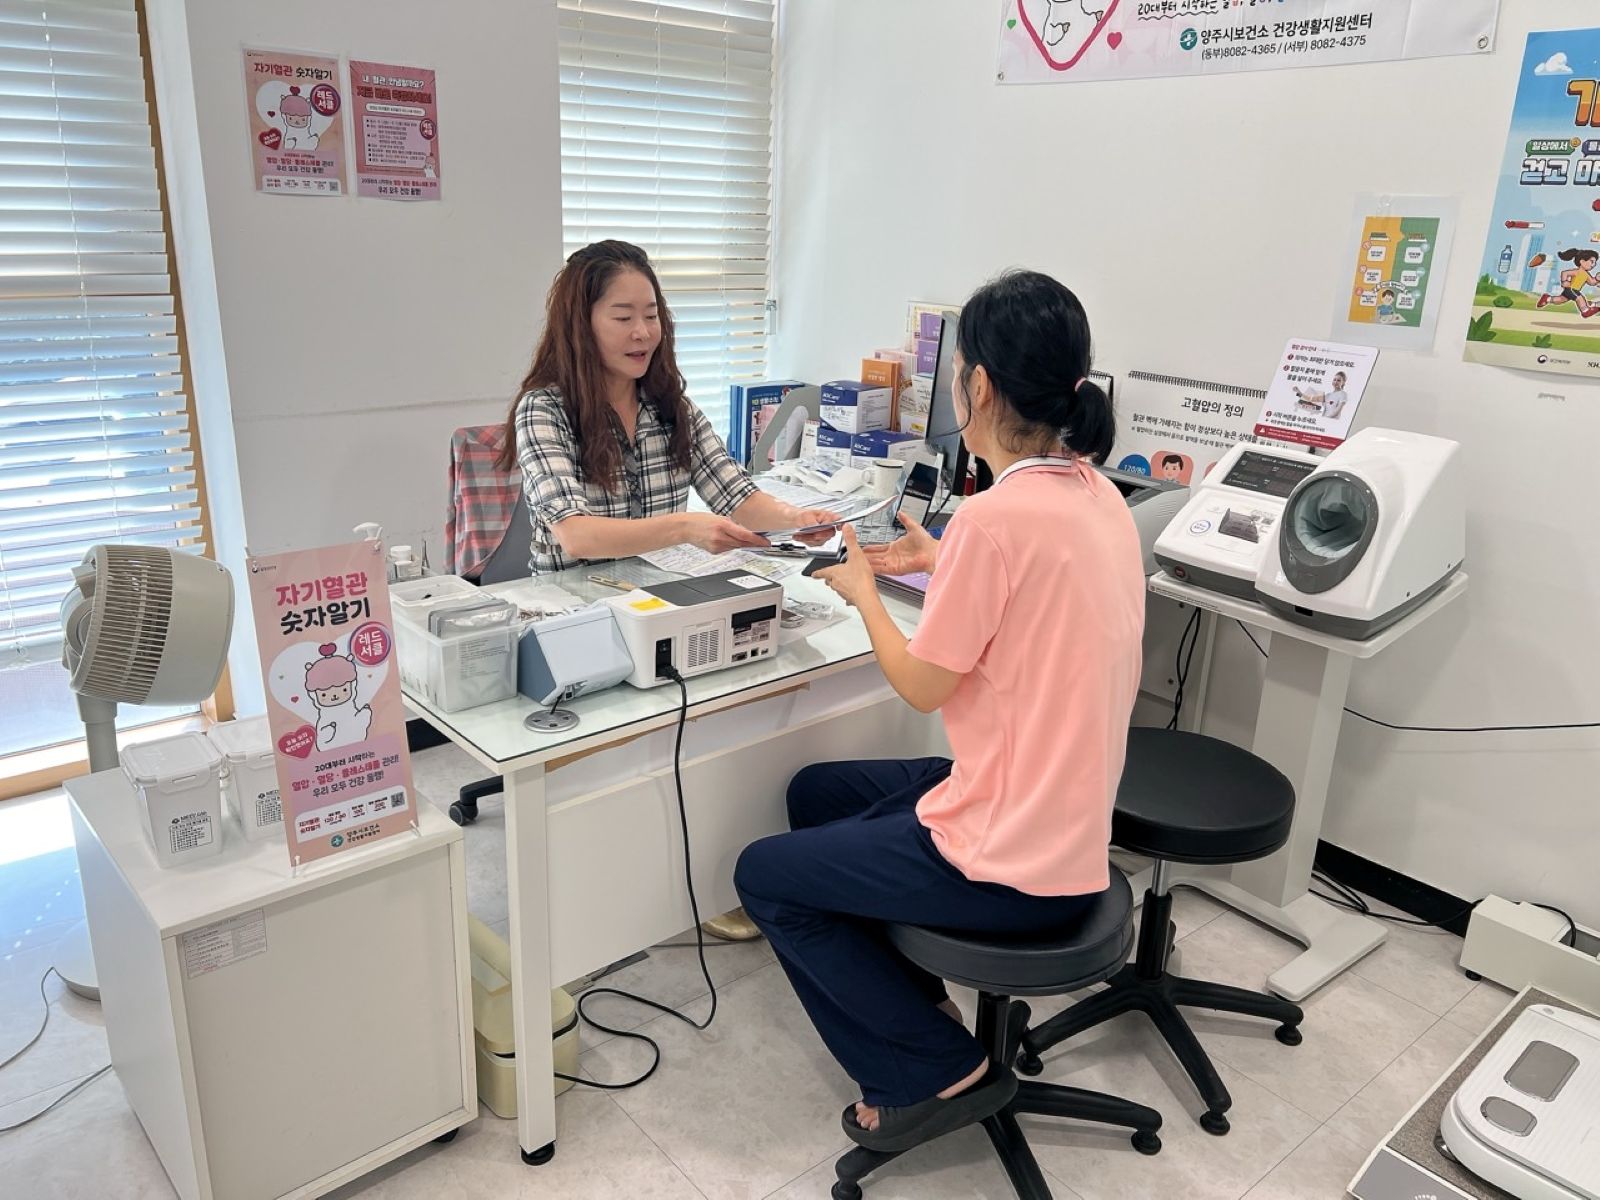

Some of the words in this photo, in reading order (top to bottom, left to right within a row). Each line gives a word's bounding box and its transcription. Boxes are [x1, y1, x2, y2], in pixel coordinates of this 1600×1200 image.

[1200, 26, 1269, 45] 양주시보건소
[1273, 12, 1373, 38] 건강생활지원센터
[1284, 40, 1308, 54] (서부)
[1310, 35, 1367, 50] 8082-4375
[254, 62, 293, 76] 자기혈관
[296, 67, 332, 80] 숫자알기
[1532, 141, 1568, 150] 일상에서
[1520, 158, 1570, 186] 걷고
[1181, 396, 1221, 414] 고혈압의
[1224, 404, 1244, 418] 정의
[1133, 413, 1145, 422] 혈관
[1159, 418, 1182, 430] 가해지는
[1184, 422, 1196, 432] 힘이
[1198, 425, 1222, 437] 정상보다
[1224, 430, 1237, 440] 높은
[276, 572, 368, 606] 자기혈관
[281, 597, 370, 635] 숫자알기
[358, 630, 382, 645] 레드
[360, 643, 384, 656] 서클
[342, 760, 381, 778] 콜레스테롤
[312, 786, 329, 798] 우리
[331, 782, 348, 793] 모두
[349, 776, 365, 788] 건강
